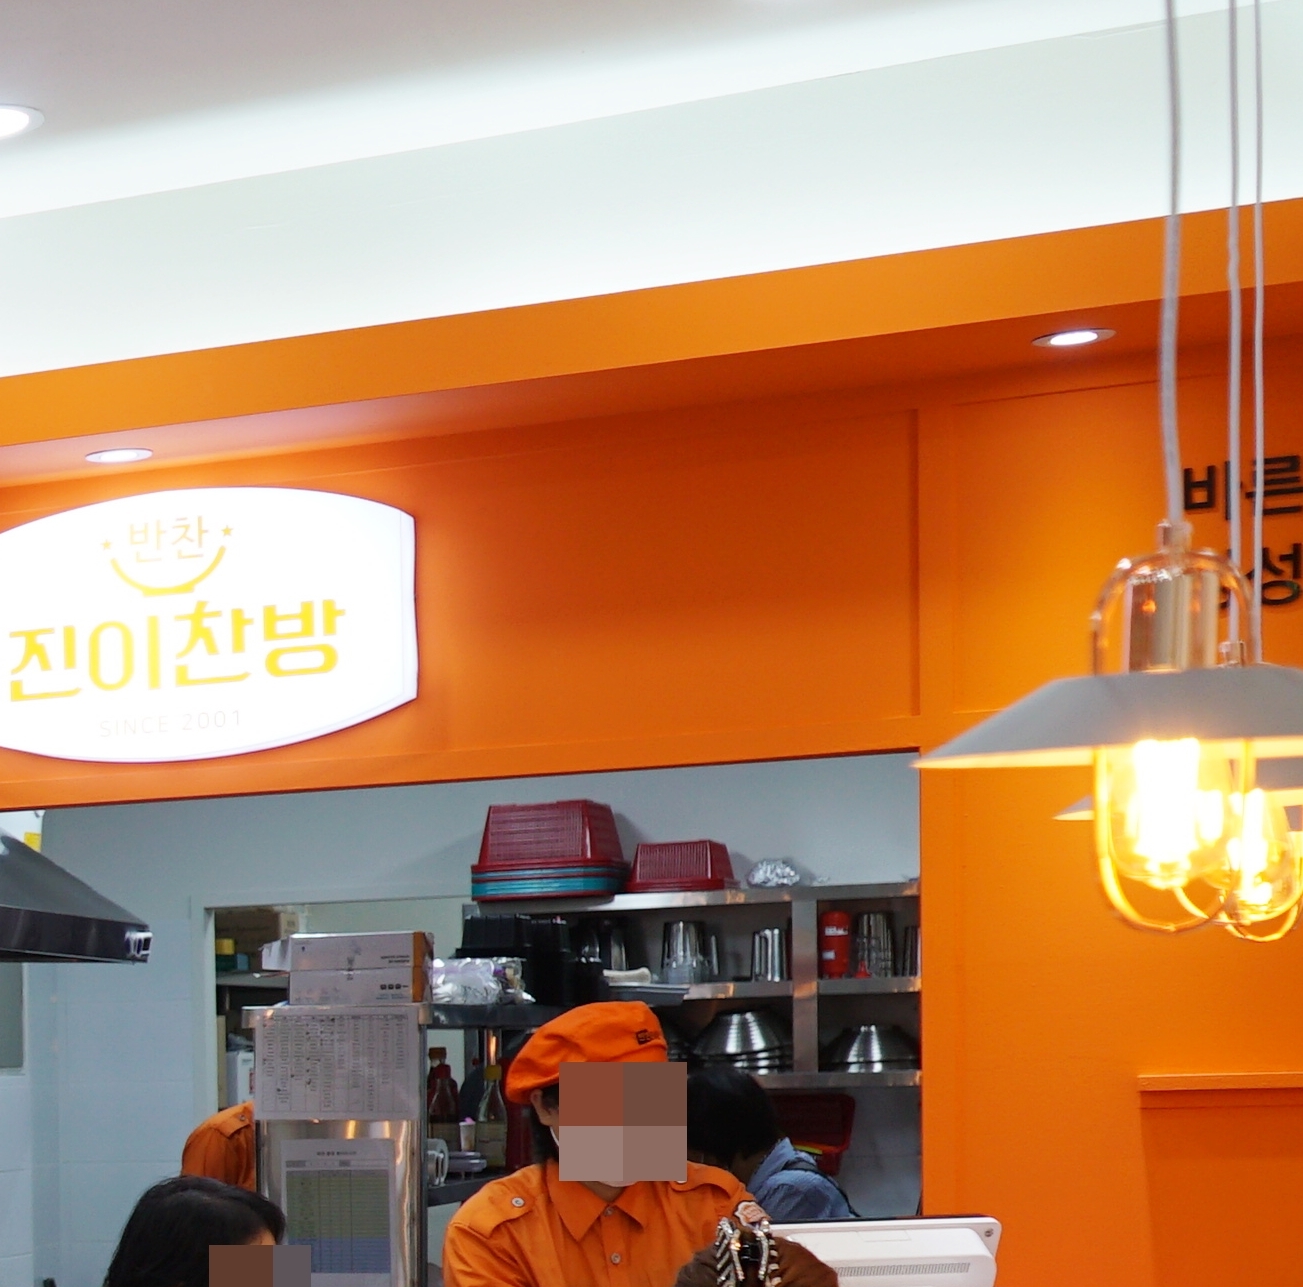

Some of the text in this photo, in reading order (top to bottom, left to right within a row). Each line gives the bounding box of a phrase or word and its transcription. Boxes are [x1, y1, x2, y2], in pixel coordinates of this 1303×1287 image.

[127, 514, 208, 564] 반찬
[8, 598, 347, 703] 진이찬방
[99, 709, 241, 738] SINCE 2001
